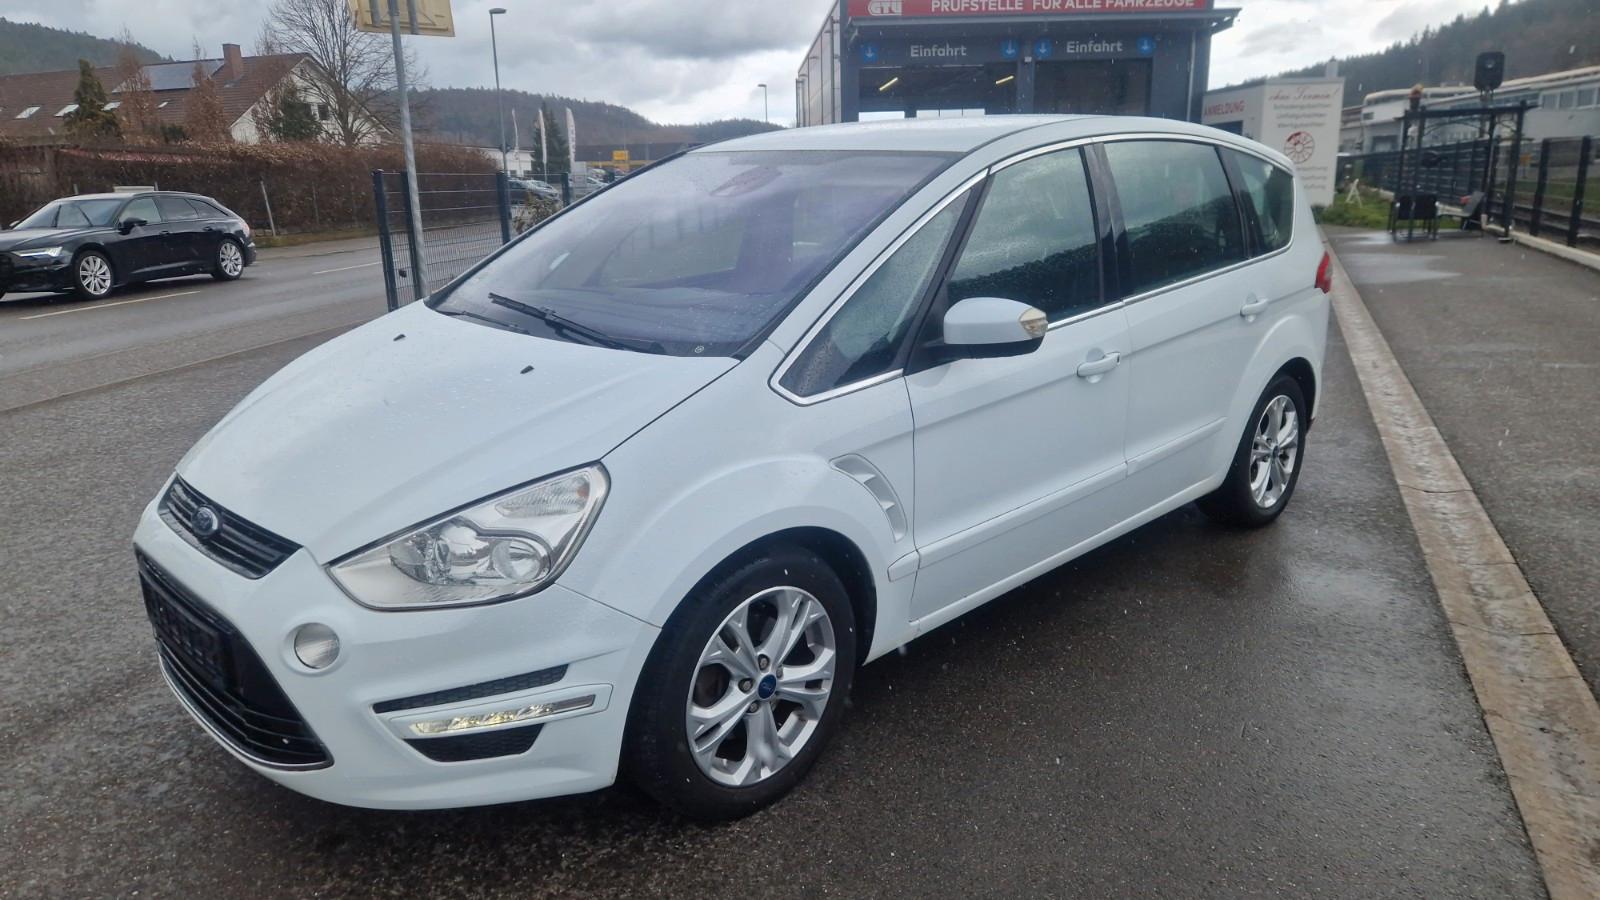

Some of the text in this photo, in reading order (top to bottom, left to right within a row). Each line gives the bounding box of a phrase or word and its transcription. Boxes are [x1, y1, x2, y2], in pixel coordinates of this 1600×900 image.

[1063, 0, 1102, 9] ALLE
[910, 43, 967, 58] Einfahrt
[1066, 40, 1123, 54] Einfahrt
